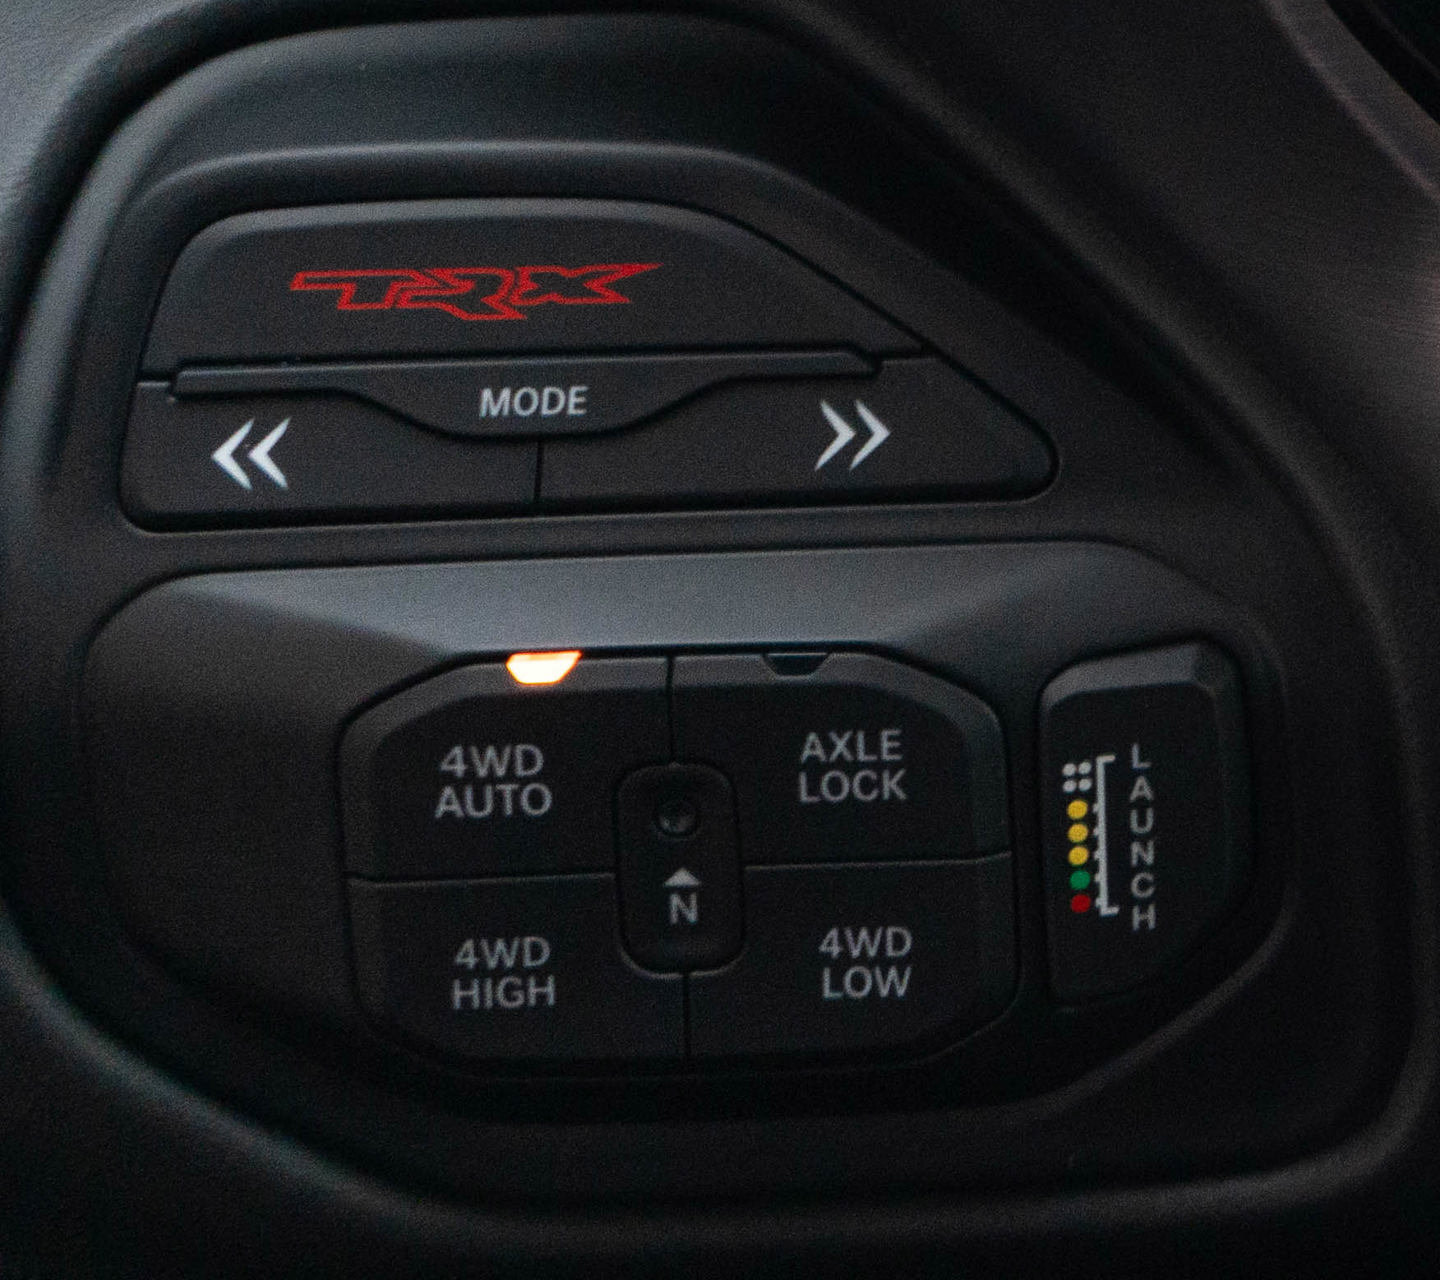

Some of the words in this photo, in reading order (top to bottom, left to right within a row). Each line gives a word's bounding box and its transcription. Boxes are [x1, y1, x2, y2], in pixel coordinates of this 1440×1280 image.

[289, 263, 664, 322] TRX
[479, 386, 589, 420] MODE
[440, 743, 545, 778] 4WD
[800, 729, 904, 764] AXLE
[434, 782, 554, 820] AUTO
[797, 768, 908, 804] LOCK
[1128, 744, 1158, 931] LAUNCH
[669, 893, 699, 925] N
[454, 935, 552, 972] 4WD
[819, 926, 913, 961] 4WD
[450, 974, 557, 1011] HIGH
[820, 965, 912, 1001] LOW
